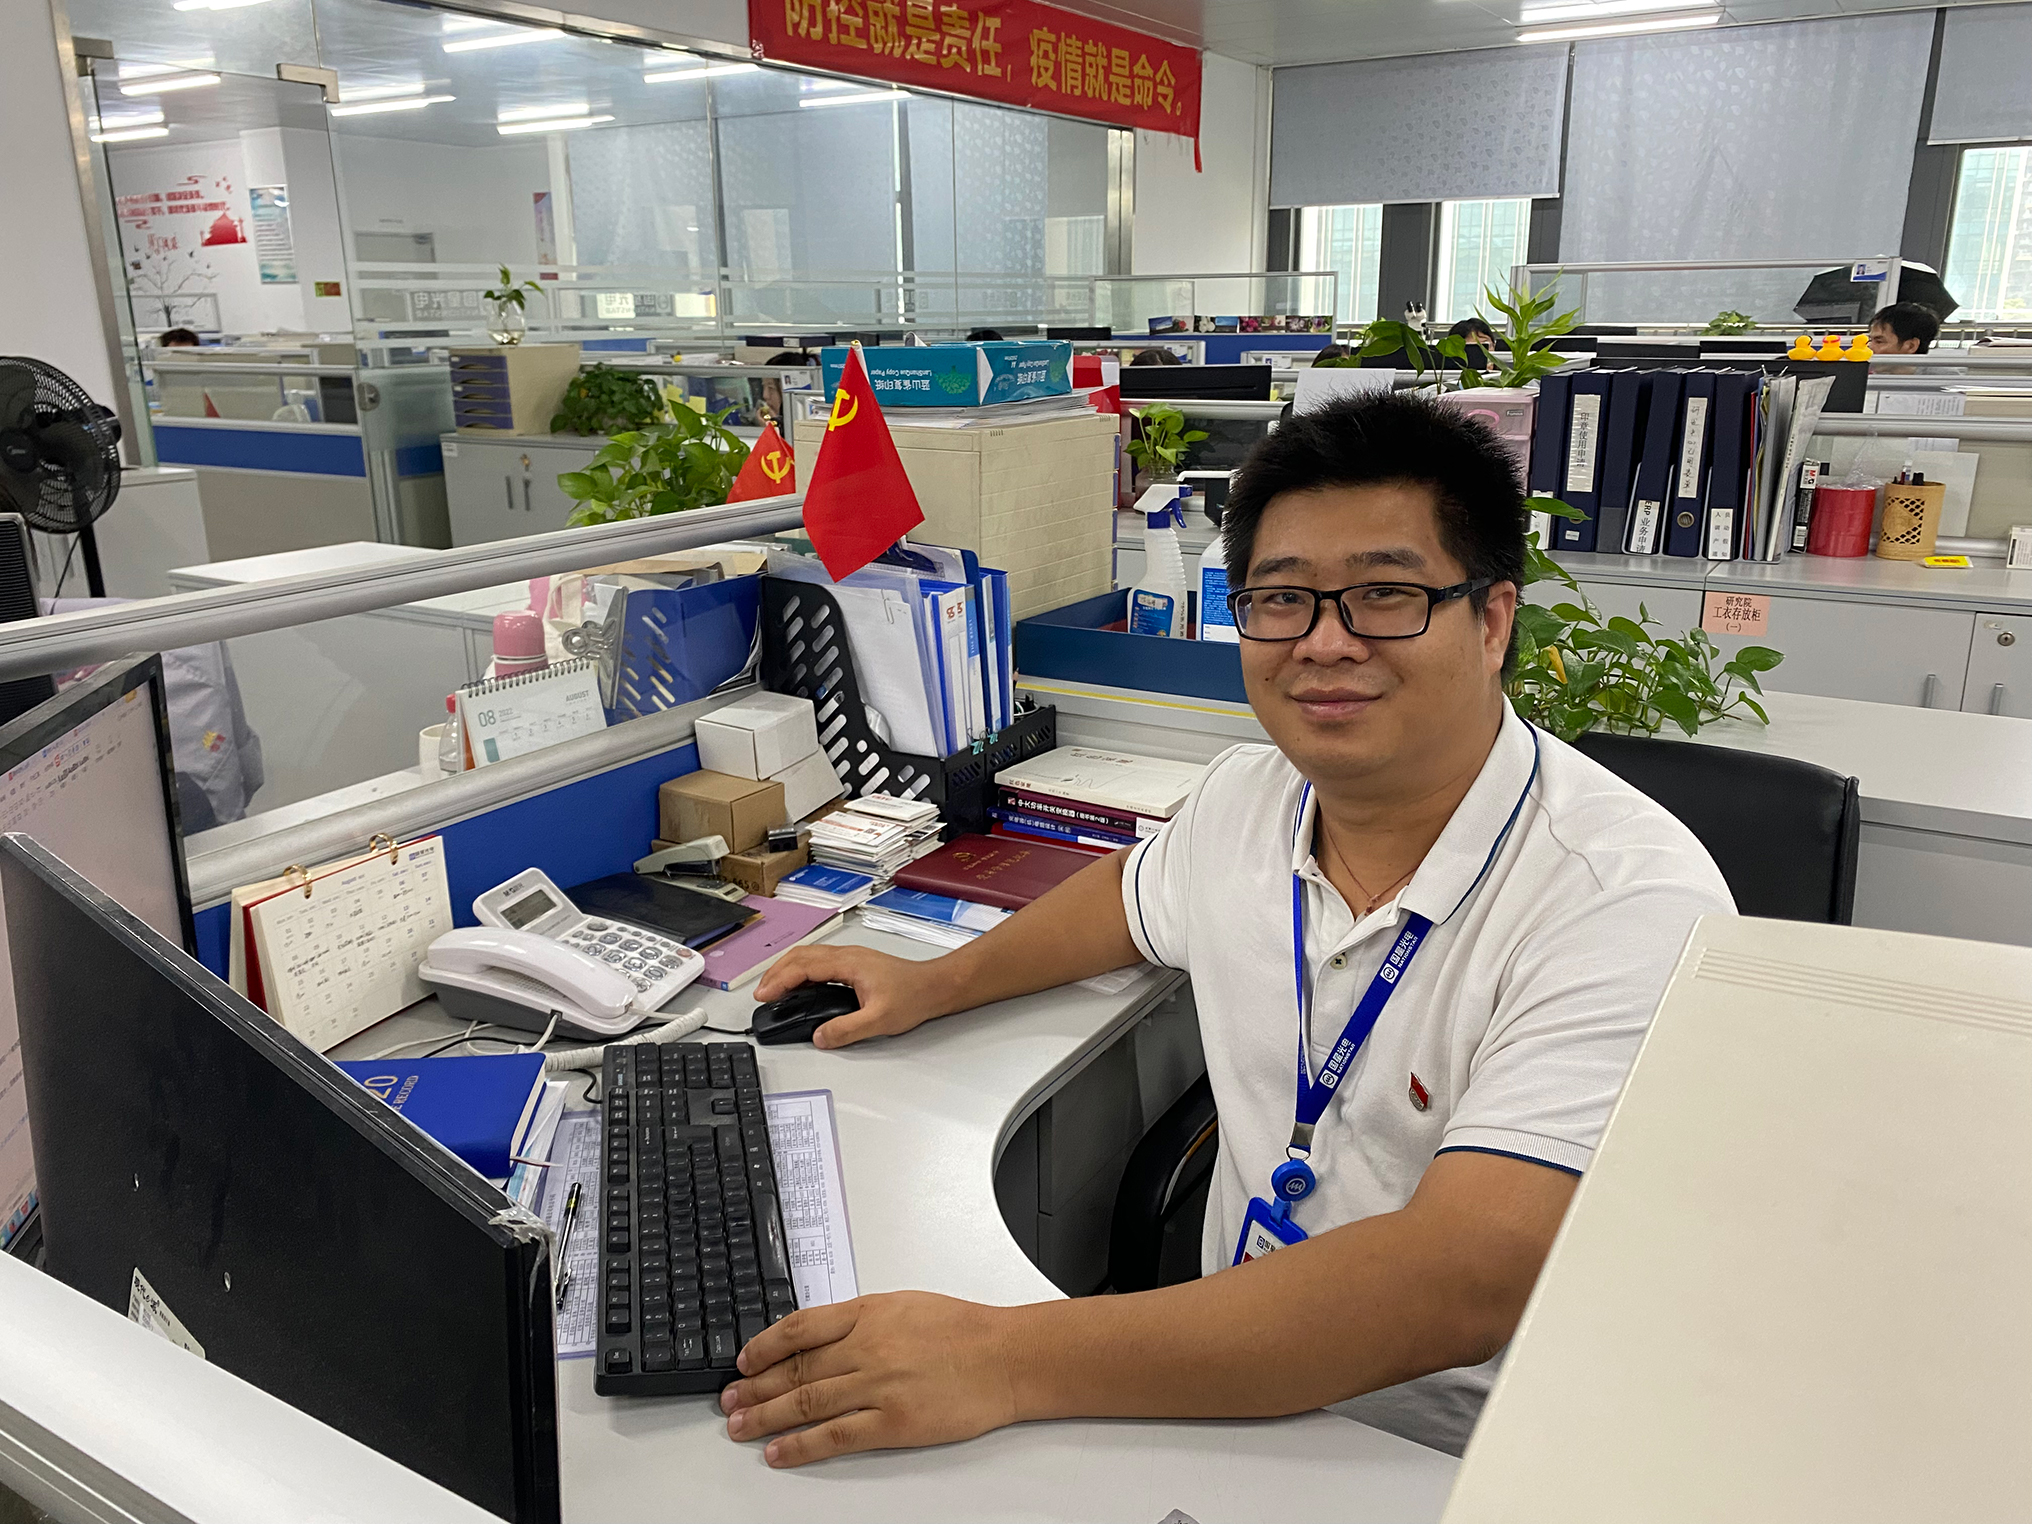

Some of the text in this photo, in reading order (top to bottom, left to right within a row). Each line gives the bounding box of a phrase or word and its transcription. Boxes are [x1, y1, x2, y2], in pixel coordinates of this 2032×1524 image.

[1712, 606, 1761, 622] 工衣存放柜
[1725, 596, 1752, 608] 研究院
[565, 690, 590, 702] AUGUST
[478, 709, 497, 728] 08
[1389, 930, 1414, 965] 国星光电
[1397, 935, 1419, 968] NATIONSTAR
[1327, 1037, 1351, 1071] 国星光电
[1336, 1042, 1356, 1074] NATIONSTAR
